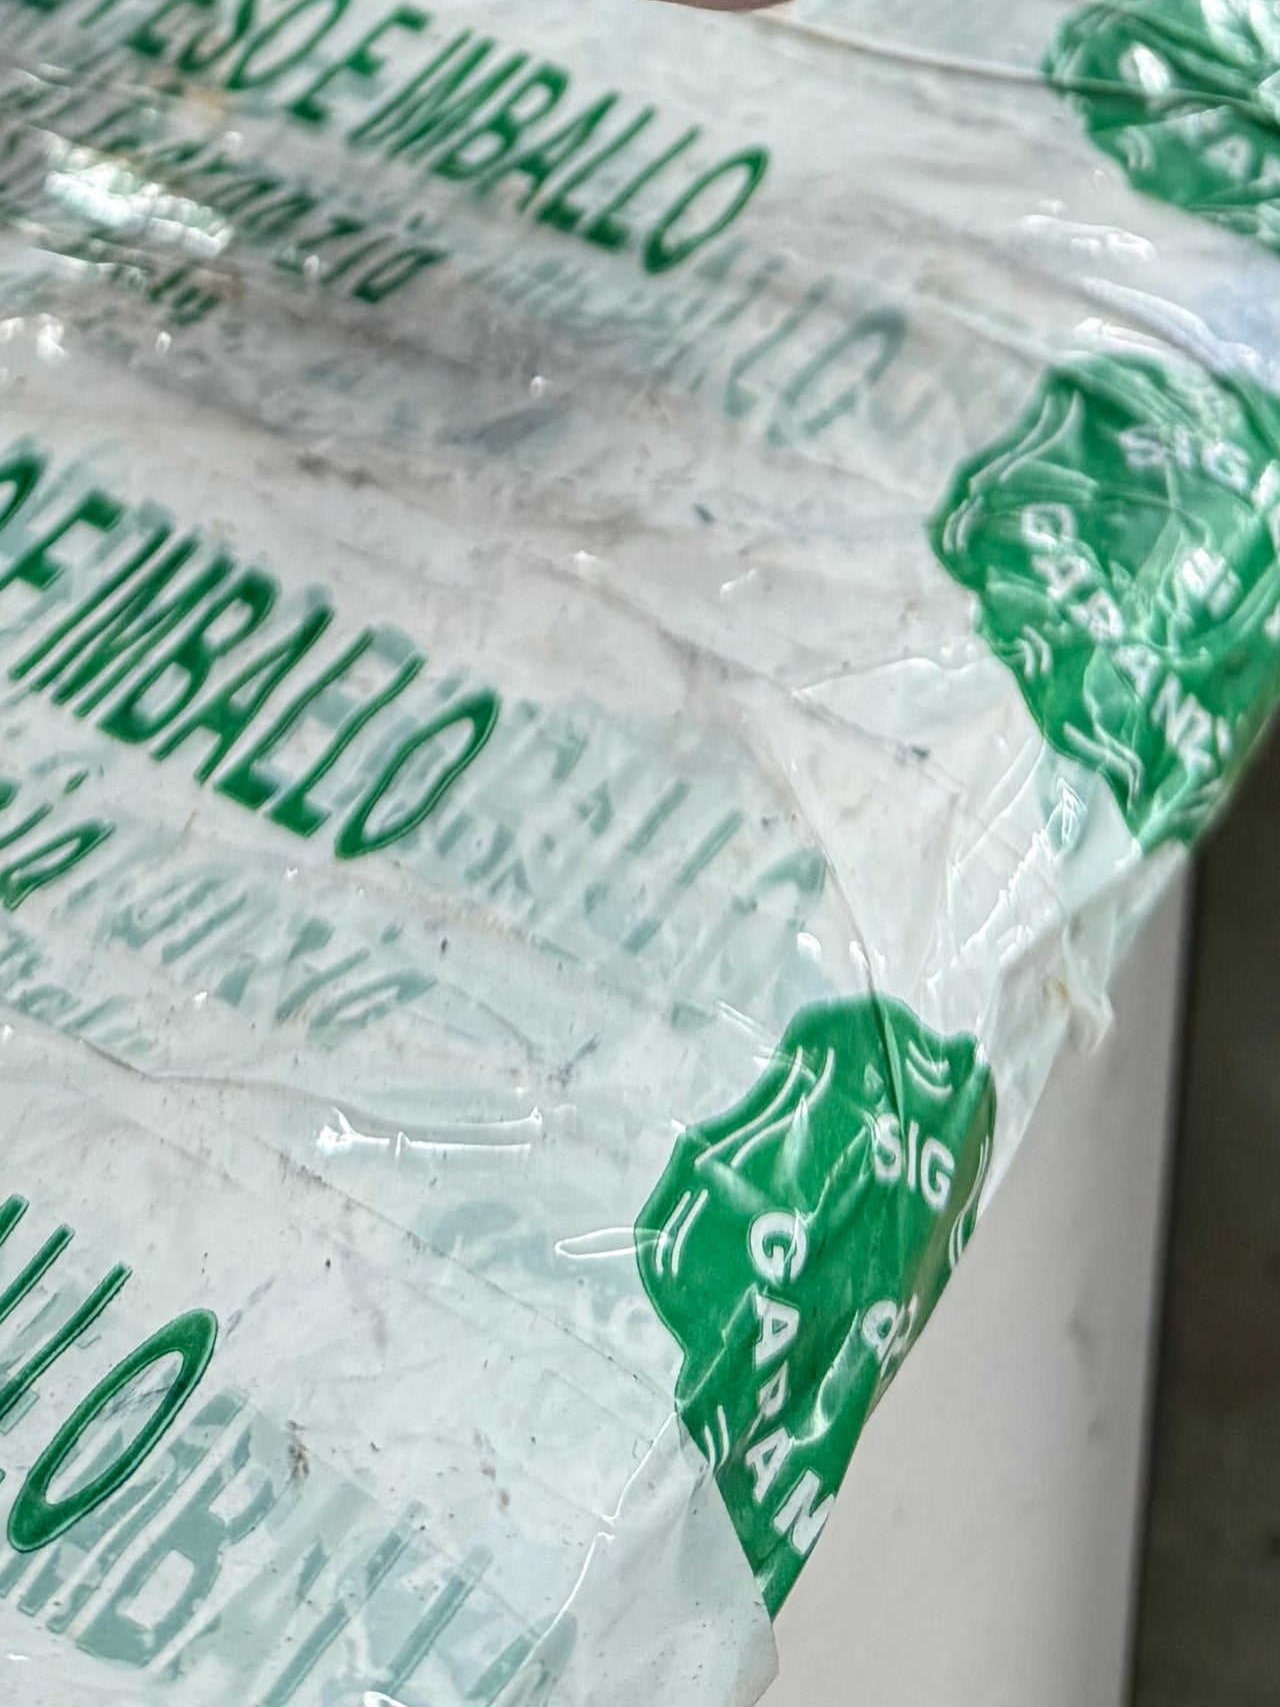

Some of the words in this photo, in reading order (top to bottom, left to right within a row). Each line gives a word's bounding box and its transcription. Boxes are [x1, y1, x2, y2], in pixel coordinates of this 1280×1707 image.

[283, 2, 433, 124] E
[346, 25, 774, 277] IMBALLO
[7, 522, 501, 860] IMBALLO
